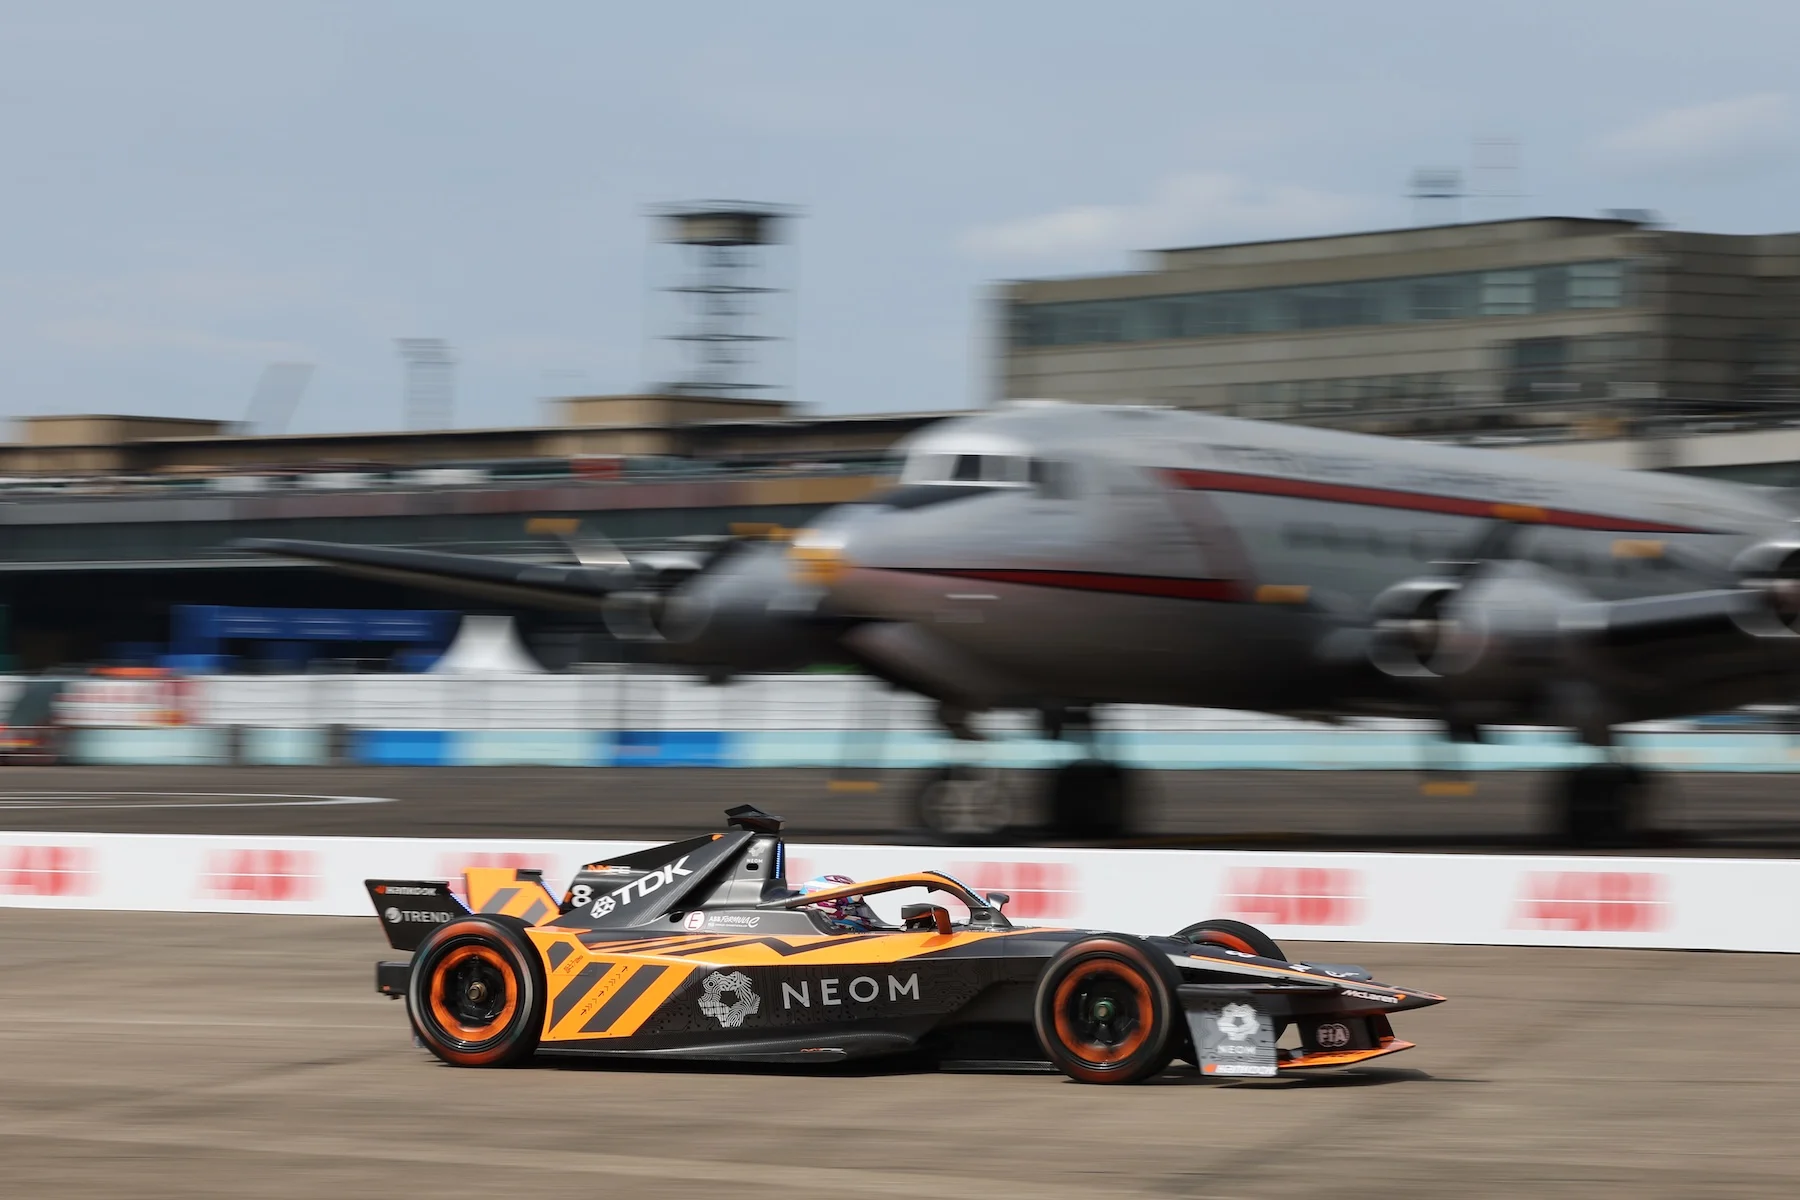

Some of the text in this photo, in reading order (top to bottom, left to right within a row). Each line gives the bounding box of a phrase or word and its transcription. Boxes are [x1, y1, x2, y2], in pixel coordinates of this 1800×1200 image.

[612, 855, 693, 905] TDK
[571, 885, 592, 907] 8
[401, 911, 451, 923] TREND
[782, 973, 920, 1009] NEOM
[1217, 1045, 1256, 1054] NEOM
